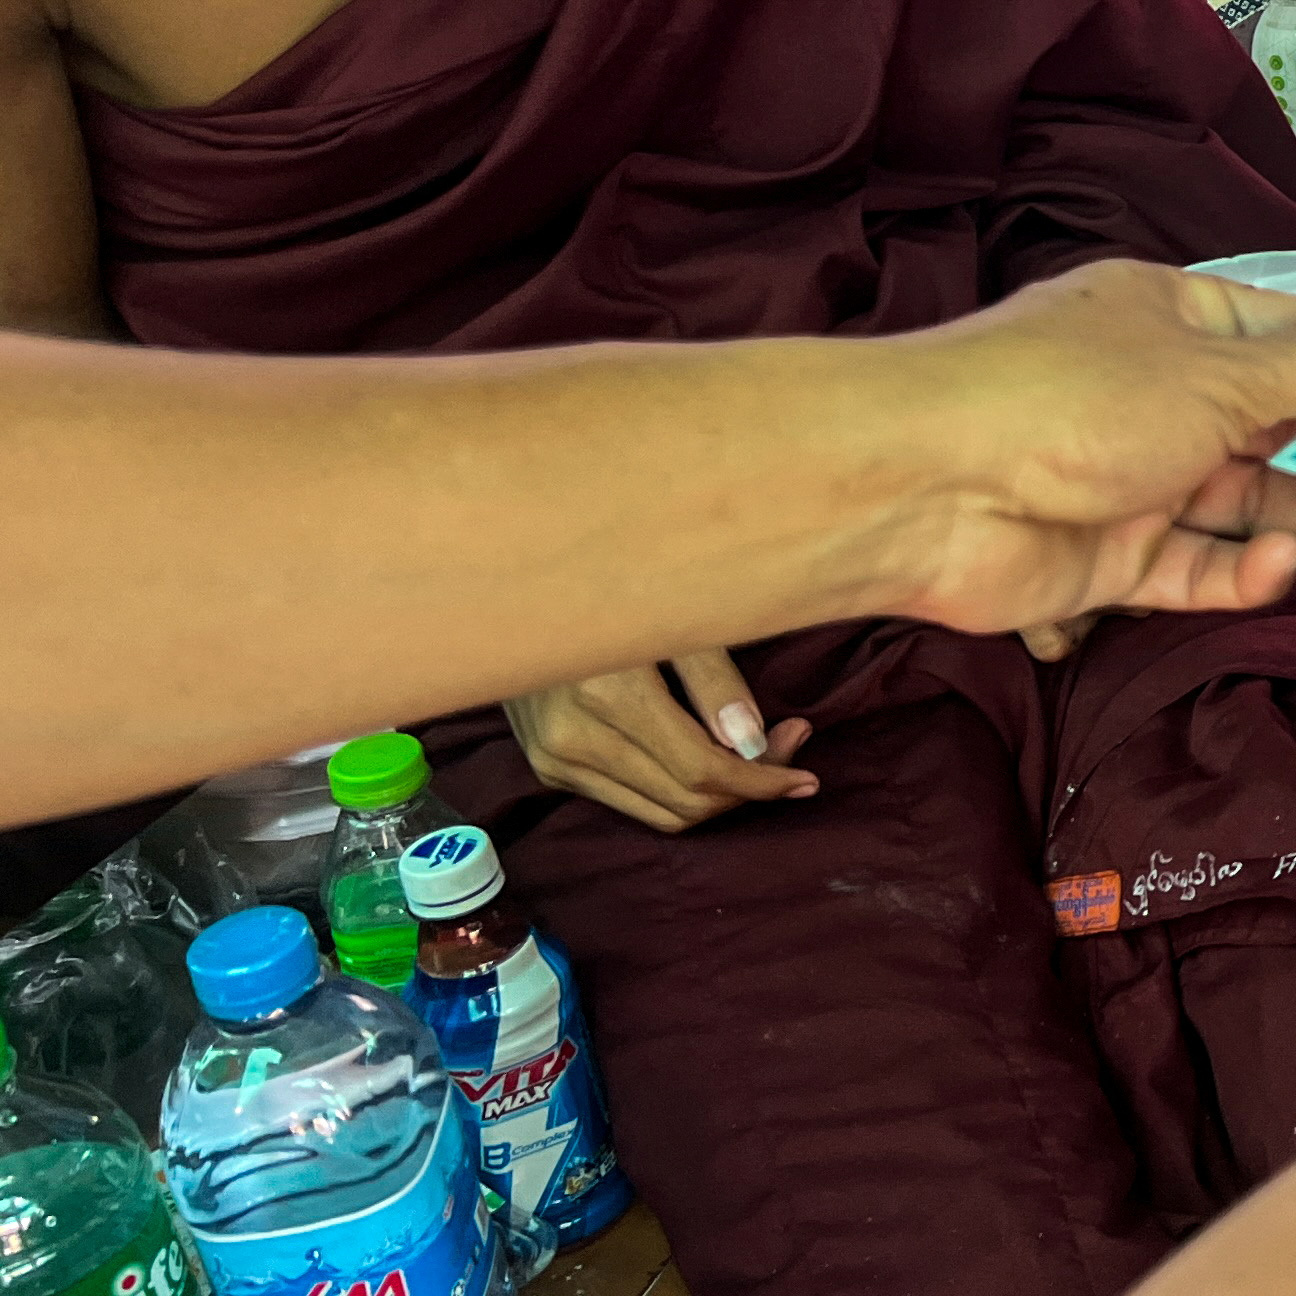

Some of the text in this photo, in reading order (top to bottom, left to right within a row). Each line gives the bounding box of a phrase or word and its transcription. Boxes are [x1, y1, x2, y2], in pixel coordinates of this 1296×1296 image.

[450, 1037, 578, 1103] VITA
[483, 1080, 552, 1119] MAX
[484, 1142, 512, 1171] B
